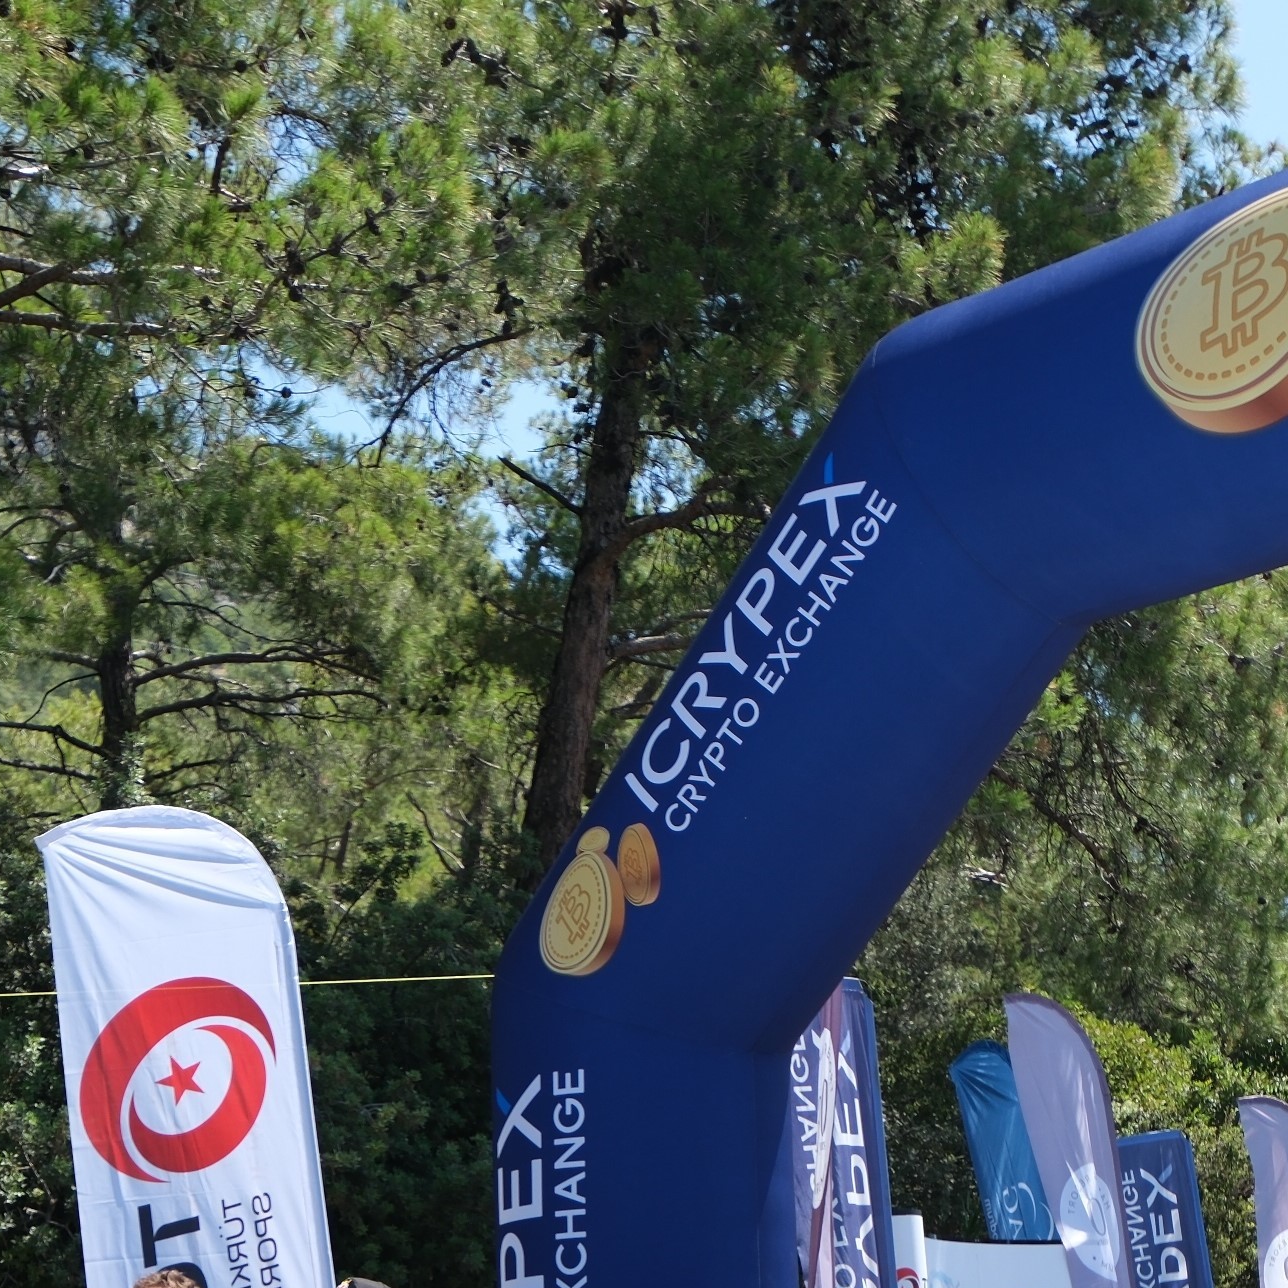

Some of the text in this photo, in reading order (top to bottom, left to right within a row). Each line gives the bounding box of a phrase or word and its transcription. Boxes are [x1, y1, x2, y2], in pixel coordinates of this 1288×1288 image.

[624, 452, 867, 813] ICRYPEX
[664, 489, 898, 832] CRYPTO EXCHANGE
